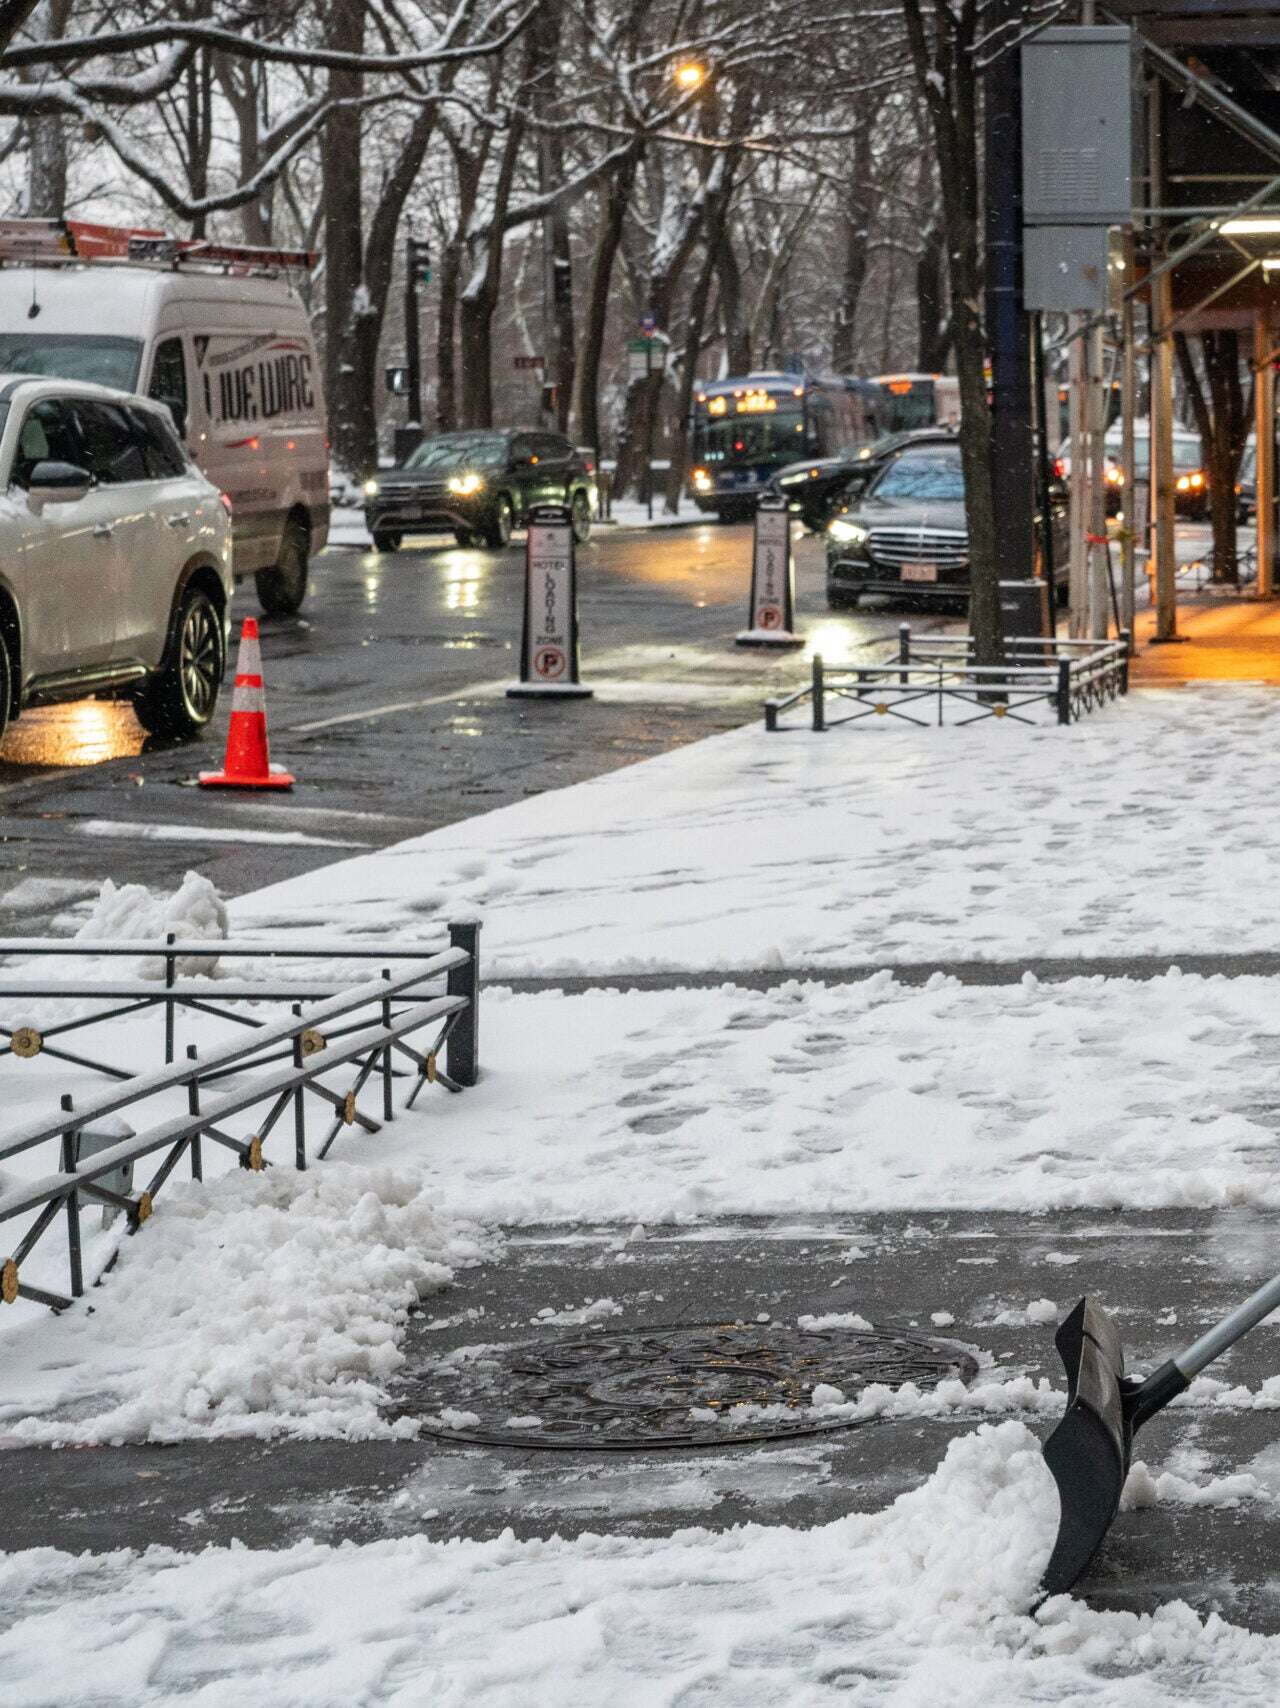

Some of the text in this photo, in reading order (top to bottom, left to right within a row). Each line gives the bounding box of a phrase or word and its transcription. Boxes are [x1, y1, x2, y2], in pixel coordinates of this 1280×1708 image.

[259, 353, 315, 418] WIRE
[544, 572, 557, 633] LOADING
[536, 635, 563, 646] ZONE
